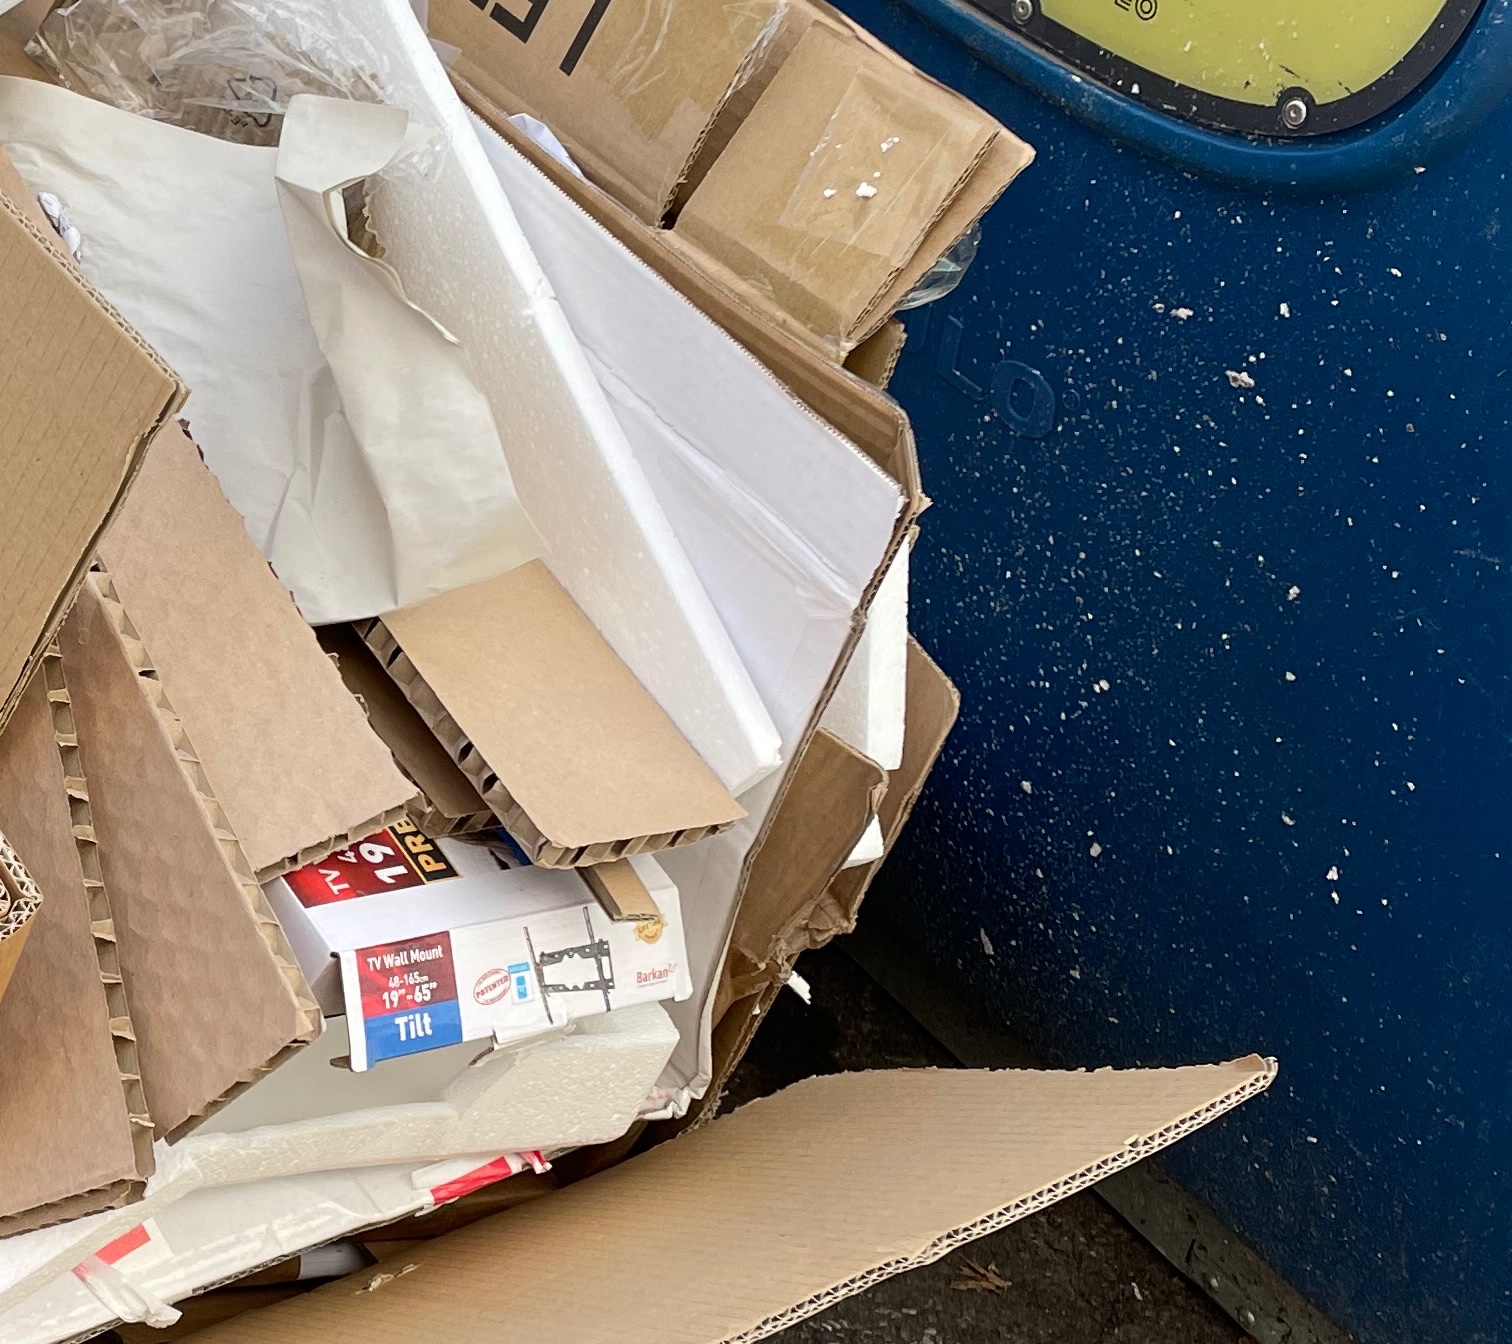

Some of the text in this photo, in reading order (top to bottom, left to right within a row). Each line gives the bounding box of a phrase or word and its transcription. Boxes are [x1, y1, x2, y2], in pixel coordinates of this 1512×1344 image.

[358, 841, 410, 885] 19
[317, 867, 351, 896] TV
[366, 944, 445, 973] TV Wall Mount
[475, 974, 510, 1000] PATENTED
[636, 967, 670, 984] Barkan
[394, 1011, 434, 1042] Tilt
